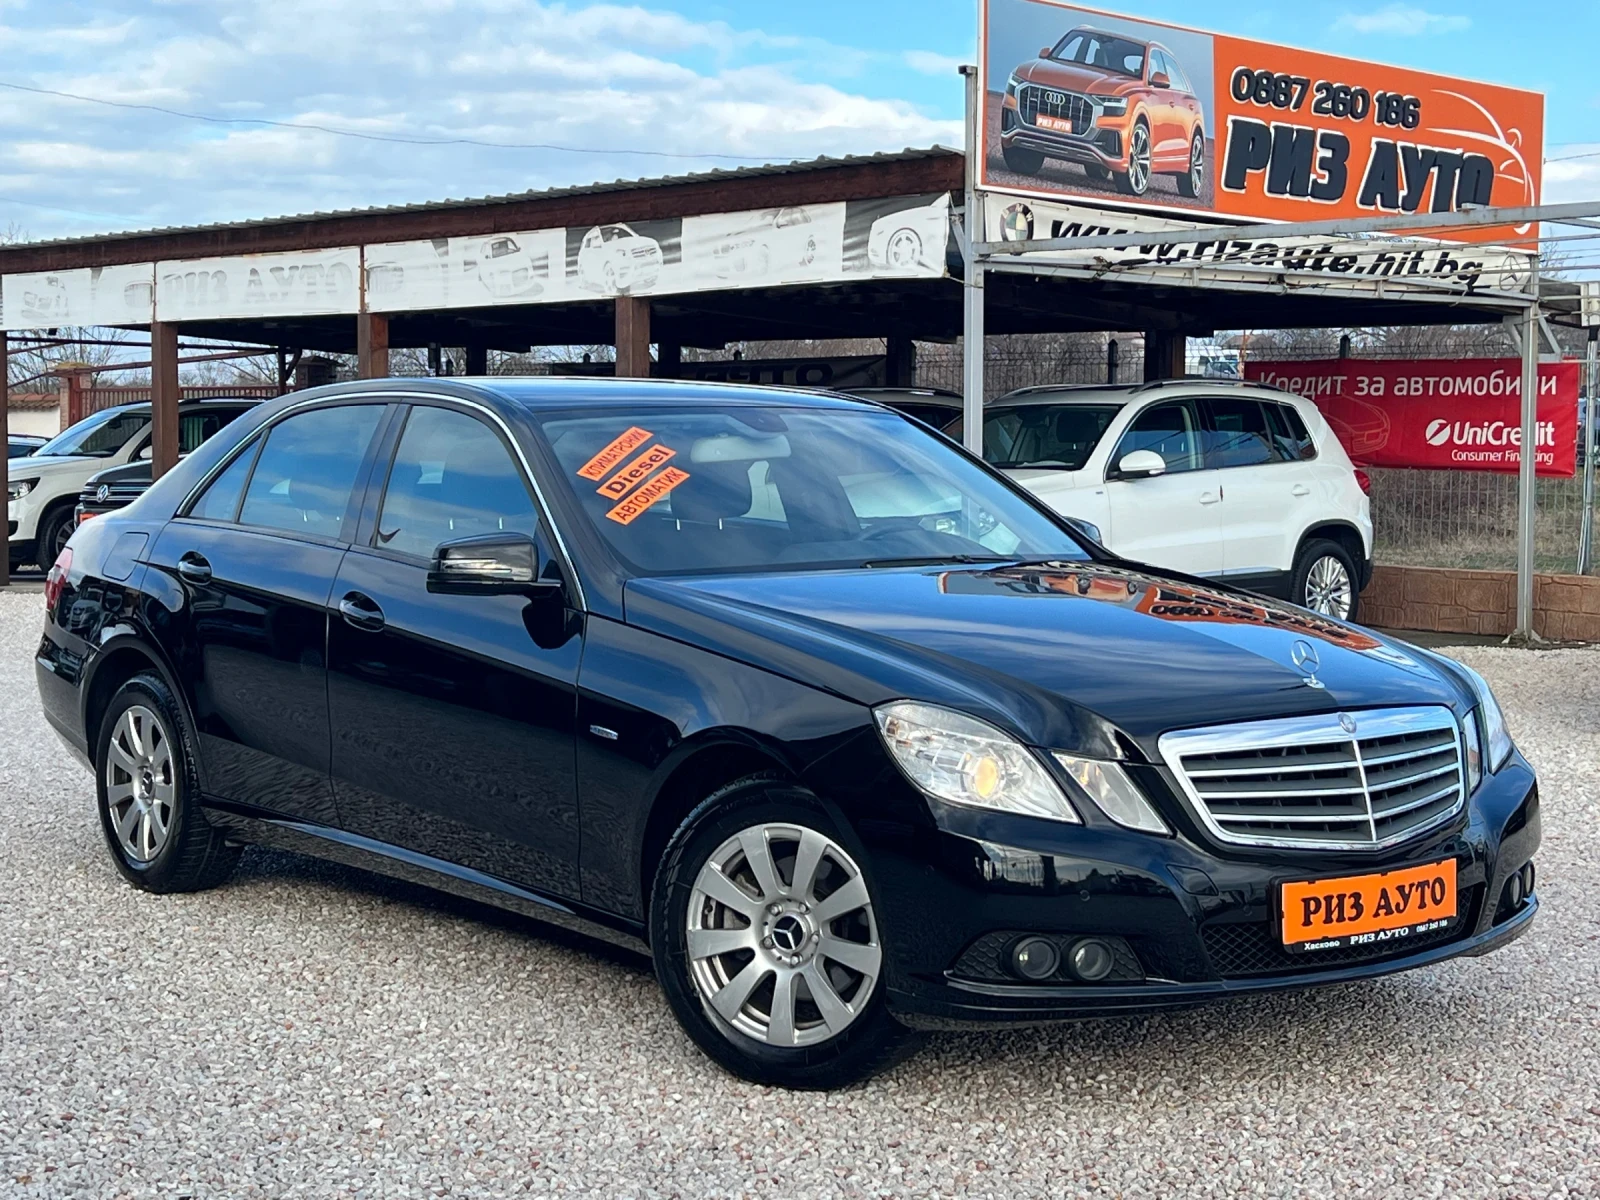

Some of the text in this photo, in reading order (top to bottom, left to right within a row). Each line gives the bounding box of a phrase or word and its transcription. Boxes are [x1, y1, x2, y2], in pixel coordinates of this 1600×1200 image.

[1231, 66, 1421, 130] 0887 260 186
[1222, 115, 1494, 213] РИЗ АУТО
[1354, 376, 1384, 396] за
[1393, 370, 1557, 397] автомобии
[584, 430, 648, 477] КЛИМАТРОНИК
[606, 448, 669, 493] Diesel
[1451, 450, 1554, 465] Consumer Fining
[615, 470, 684, 520] АВТОМАТИК
[1301, 877, 1446, 927] РИЗ АУТО
[1350, 932, 1375, 945] РИЗ
[1377, 927, 1409, 941] АУТО
